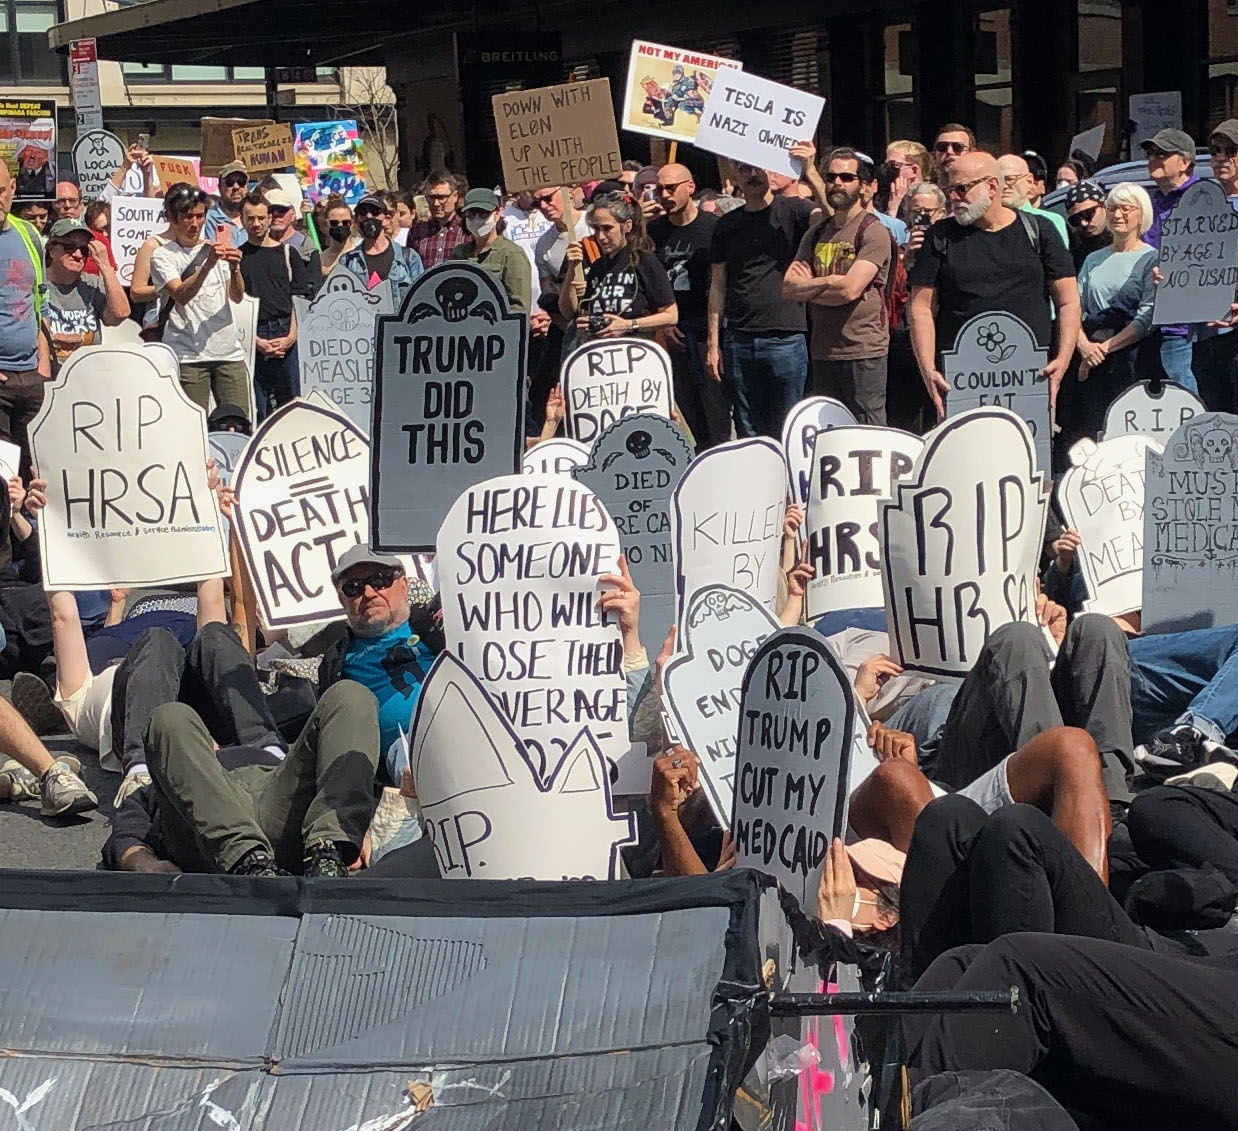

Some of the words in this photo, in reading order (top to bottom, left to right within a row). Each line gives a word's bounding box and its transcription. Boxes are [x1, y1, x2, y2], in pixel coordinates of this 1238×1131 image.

[481, 51, 560, 63] BREITLING
[638, 45, 662, 57] NOT
[664, 50, 681, 60] MY
[503, 97, 541, 118] DOWN
[551, 85, 591, 109] WITH
[725, 87, 774, 115] TESLA
[781, 107, 806, 127] IS
[237, 127, 270, 143] TRANS
[709, 112, 749, 136] NAZI
[84, 160, 121, 170] LOCAL
[511, 145, 532, 163] UP
[538, 137, 584, 158] WITH
[516, 165, 551, 186] THE
[561, 152, 619, 182] PEOPLE
[117, 207, 153, 222] SOUTH
[122, 244, 138, 257] YO
[1160, 245, 1180, 262] BY
[1180, 242, 1214, 260] AGE
[1162, 270, 1190, 288] NO
[309, 338, 353, 357] DIED
[394, 334, 505, 375] TRUMP
[587, 344, 648, 377] RIP
[303, 358, 374, 384] MEASLE
[953, 367, 1040, 391] COULDN'T
[423, 380, 474, 419] DID
[571, 381, 630, 410] DEATH
[641, 378, 662, 403] BY
[72, 394, 163, 453] RIP
[401, 419, 485, 465] THIS
[574, 405, 658, 444] DO
[254, 428, 362, 483] SILENCE
[523, 456, 578, 475] IP
[820, 449, 914, 501] RIP
[62, 460, 201, 529] HRSA
[614, 470, 671, 490] DIED
[1080, 469, 1145, 517] DEAT
[248, 485, 371, 542] DEATH
[467, 486, 549, 535] HERE
[551, 486, 608, 532] LIES
[614, 515, 643, 535] RE
[646, 511, 672, 534] CA
[628, 499, 653, 513] OF
[1118, 499, 1145, 522] BY
[1151, 498, 1222, 524] STOLE
[913, 475, 1025, 577] RIP
[263, 529, 347, 607] ACT
[456, 540, 617, 586] SOMEONE
[809, 521, 881, 582] HRS
[1089, 532, 1144, 583] MEA
[732, 552, 767, 591] BY
[457, 590, 543, 632] WHO
[550, 590, 618, 630] WILL
[457, 639, 557, 681] LOSE
[567, 638, 627, 682] THEIR
[765, 650, 820, 703] RIP
[489, 687, 627, 728] VERAGE
[746, 710, 832, 761] TRUMP
[740, 762, 779, 808] CUT
[783, 772, 826, 817] MY
